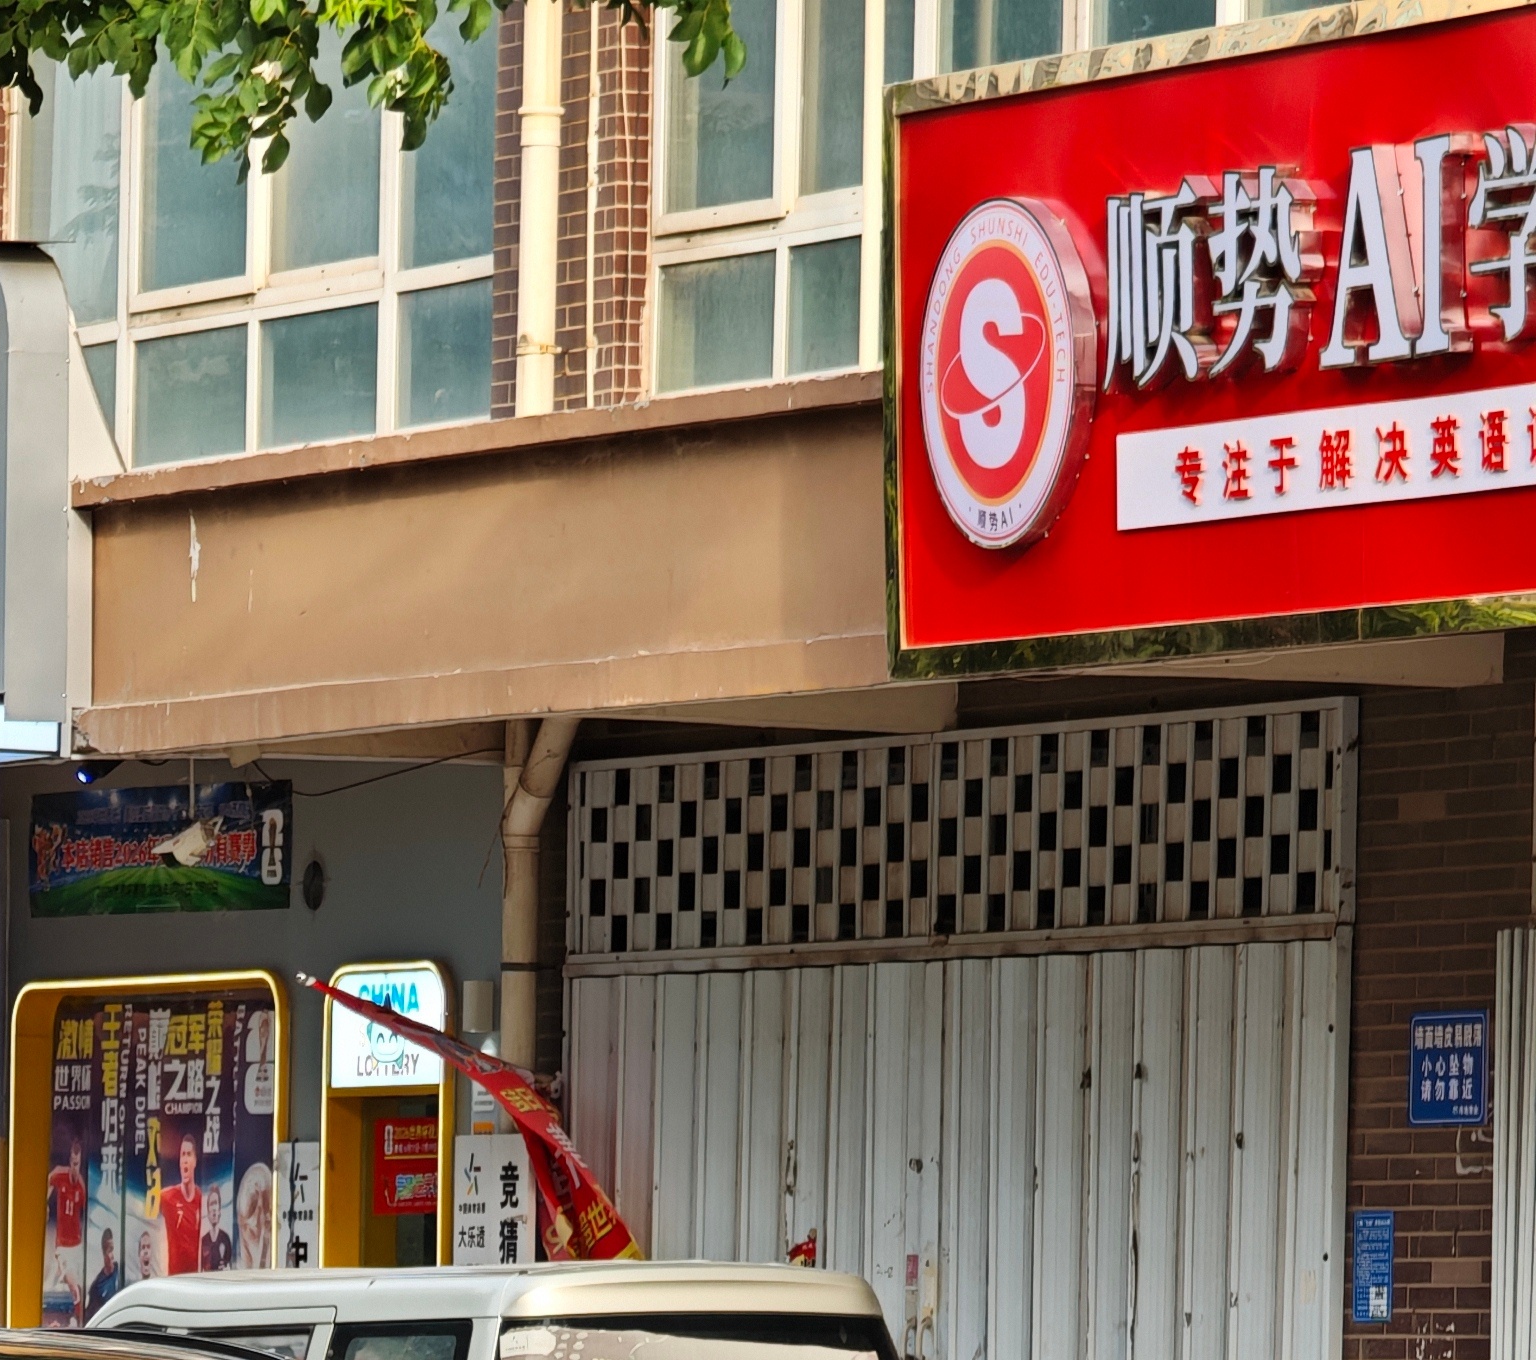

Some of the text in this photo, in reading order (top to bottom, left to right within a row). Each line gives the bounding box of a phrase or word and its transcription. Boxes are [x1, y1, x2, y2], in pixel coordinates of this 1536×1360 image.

[925, 216, 1066, 395] SHANDONG SHUNSHI EDU-TECH
[977, 506, 1014, 533] 顺势AI
[56, 1018, 94, 1060] 激情
[164, 1013, 206, 1055] 冠军
[55, 1063, 91, 1093] 世界杯
[164, 1058, 205, 1101] 之路
[1421, 1052, 1474, 1077] 小心坠物
[134, 1027, 147, 1156] PEAK DUEL
[1421, 1078, 1473, 1102] 请勿靠近
[498, 1161, 520, 1265] 竞猜
[458, 1225, 486, 1249] 大乐透
